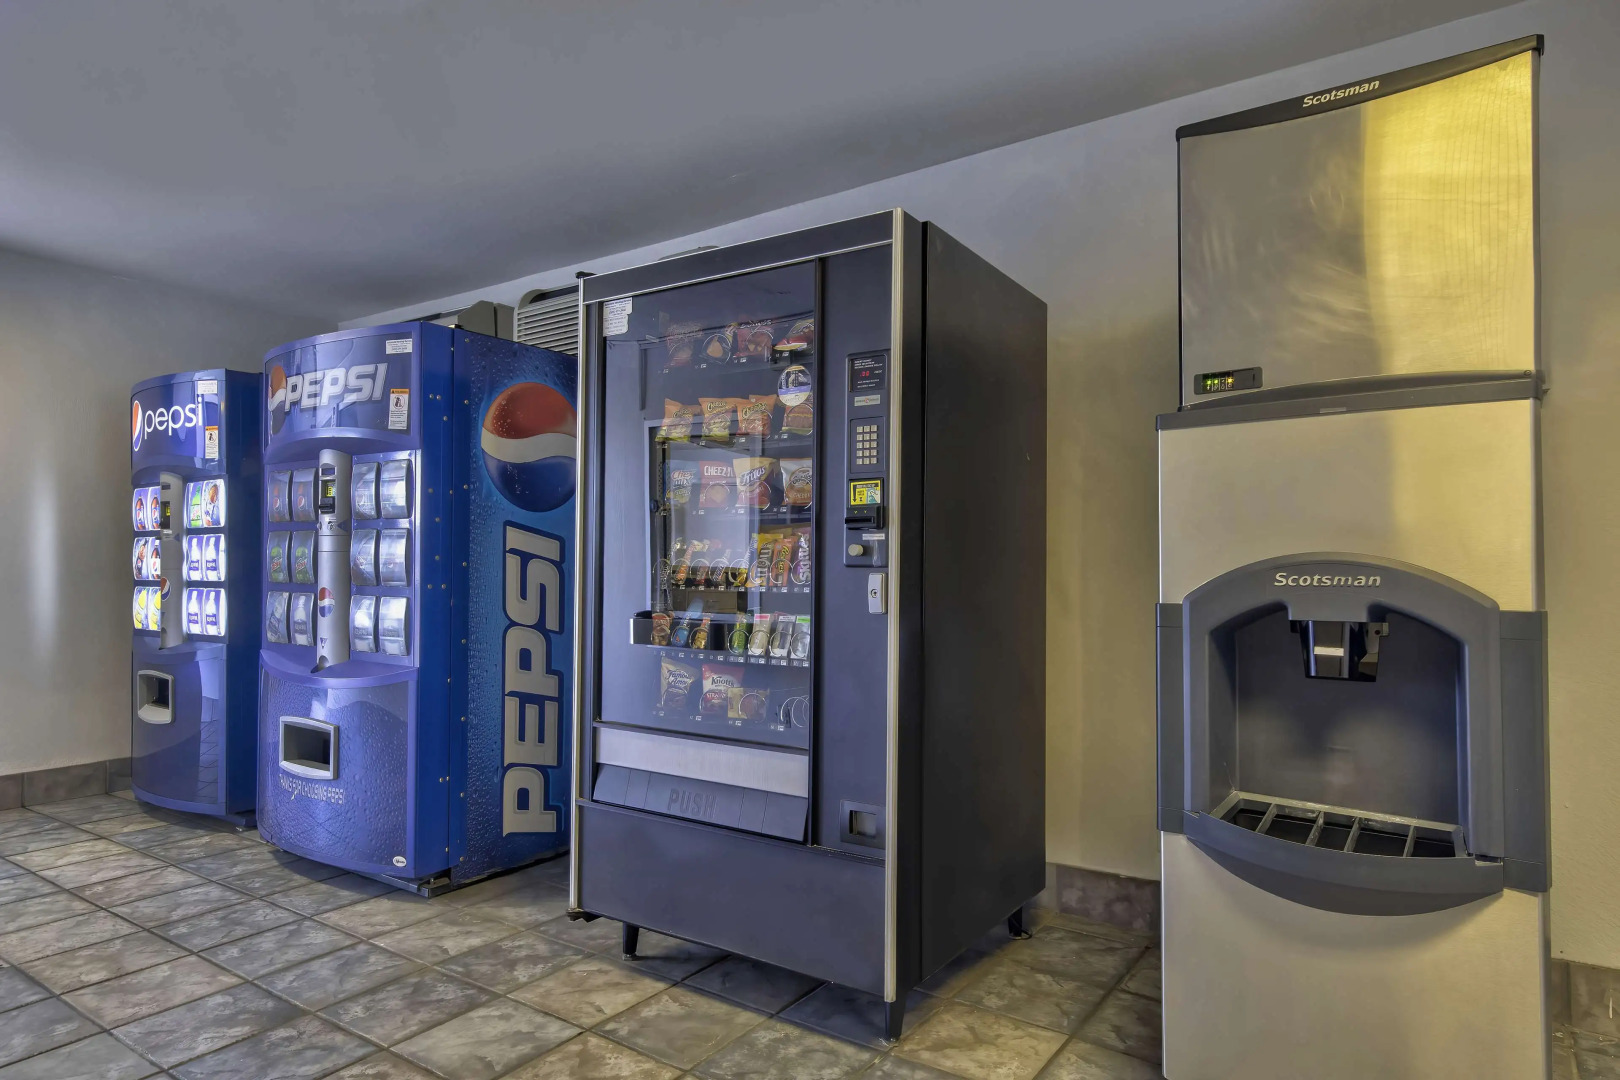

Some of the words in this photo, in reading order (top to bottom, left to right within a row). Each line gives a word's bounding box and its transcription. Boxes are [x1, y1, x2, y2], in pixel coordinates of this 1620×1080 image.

[1302, 80, 1380, 108] Scotsman
[284, 361, 389, 412] PEPSI
[144, 396, 204, 439] pepsi
[741, 466, 766, 486] Fritos
[1273, 572, 1382, 587] Scotsman
[503, 525, 561, 837] PEPSI
[667, 788, 718, 819] PUSH
